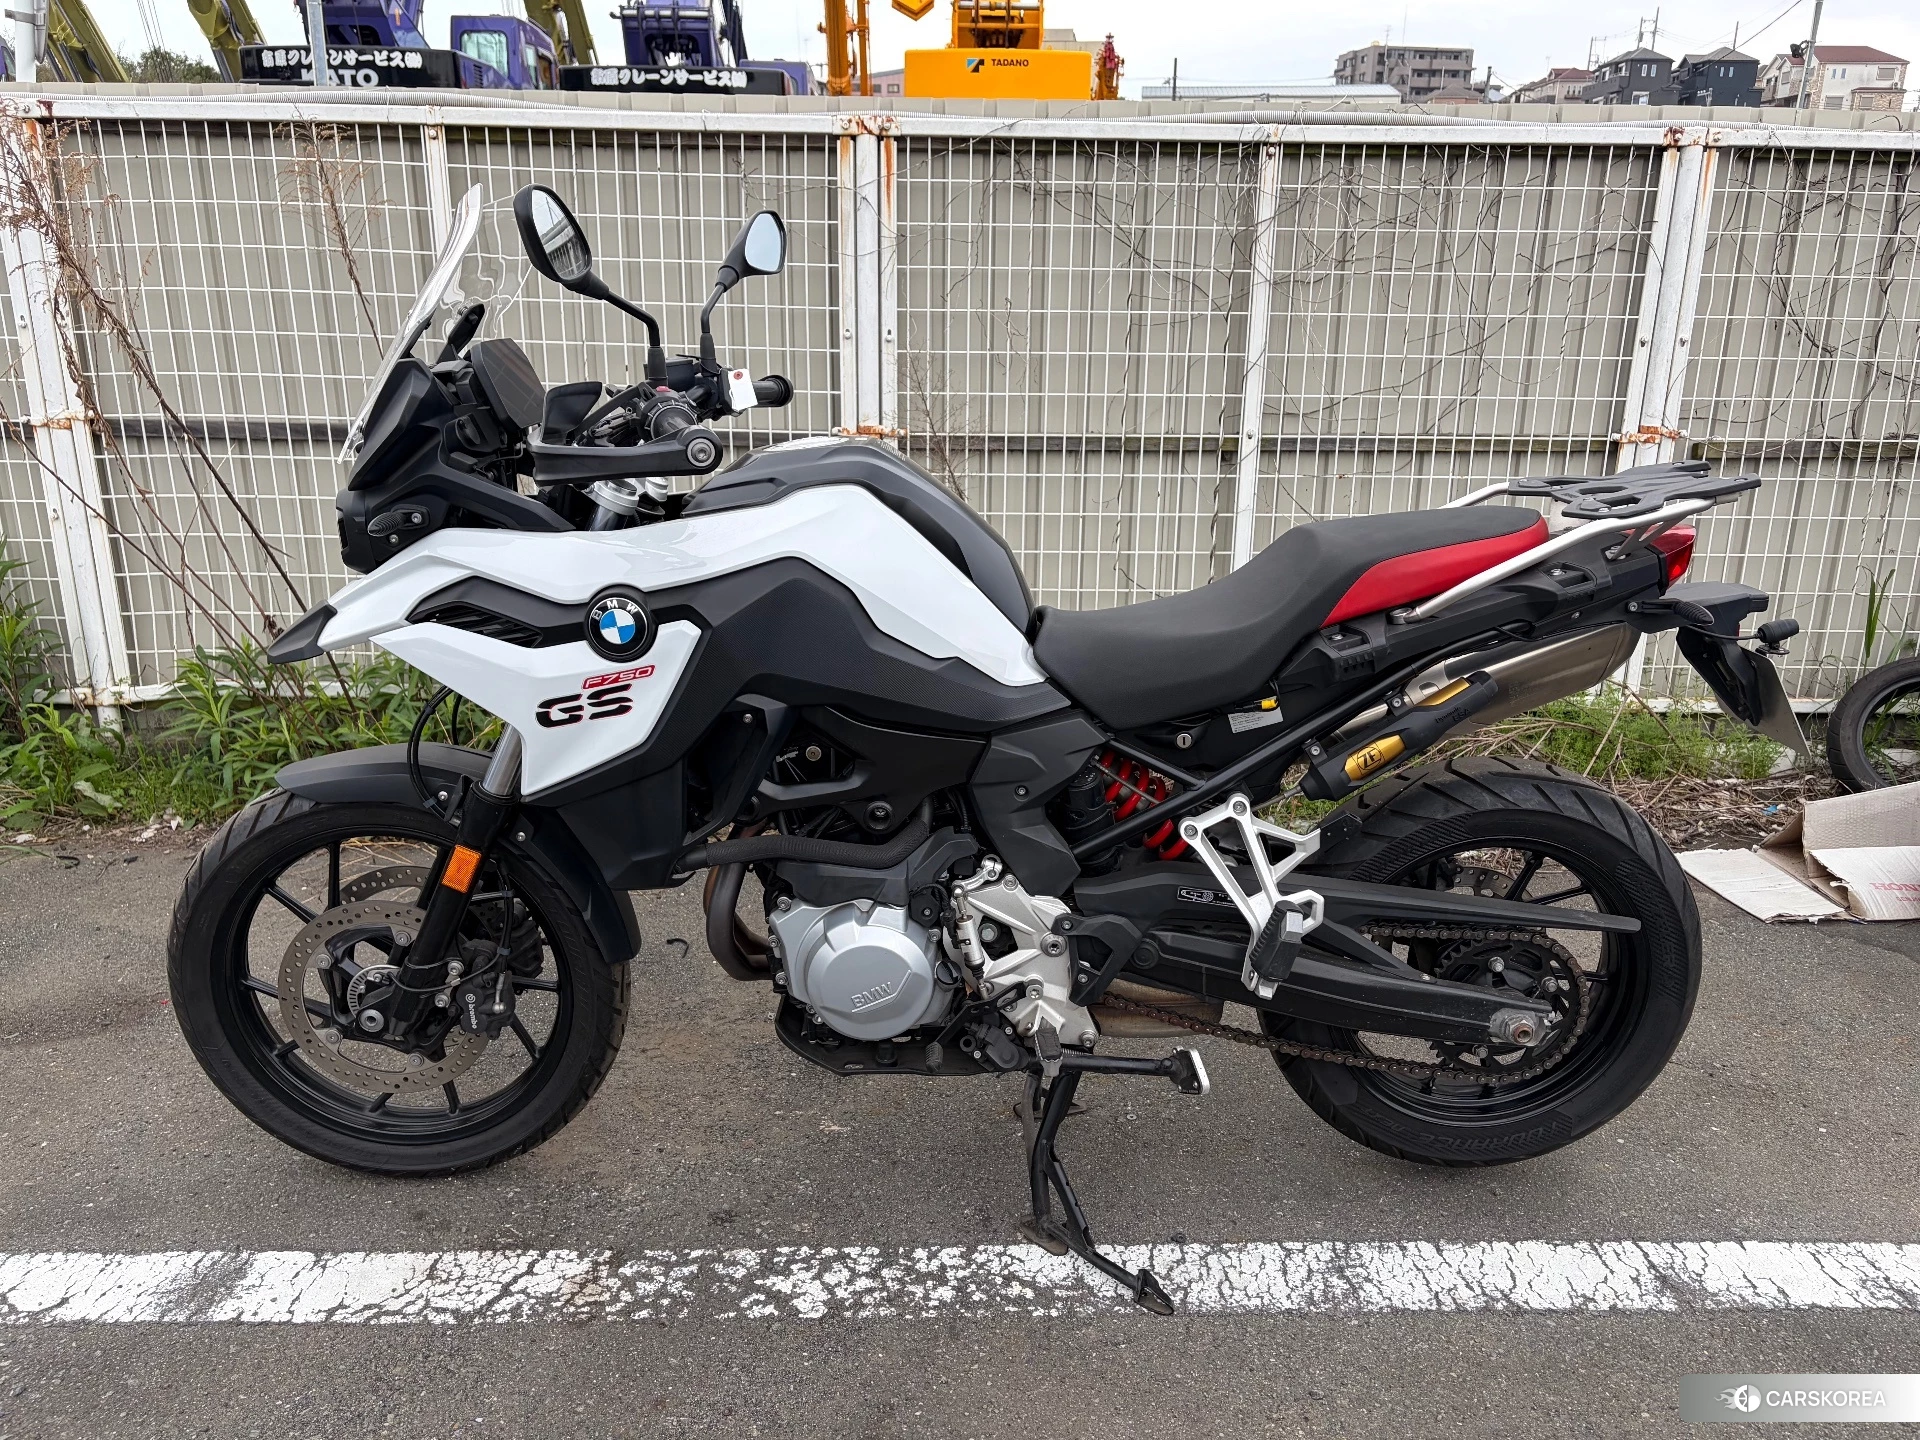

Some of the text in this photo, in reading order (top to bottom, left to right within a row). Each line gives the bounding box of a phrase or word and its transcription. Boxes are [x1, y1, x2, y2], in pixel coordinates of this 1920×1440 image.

[991, 59, 1029, 67] TADANO
[591, 600, 640, 621] BMW
[585, 666, 653, 688] F750
[535, 683, 634, 728] GS
[850, 981, 892, 1008] BMW
[468, 1003, 478, 1030] brembo
